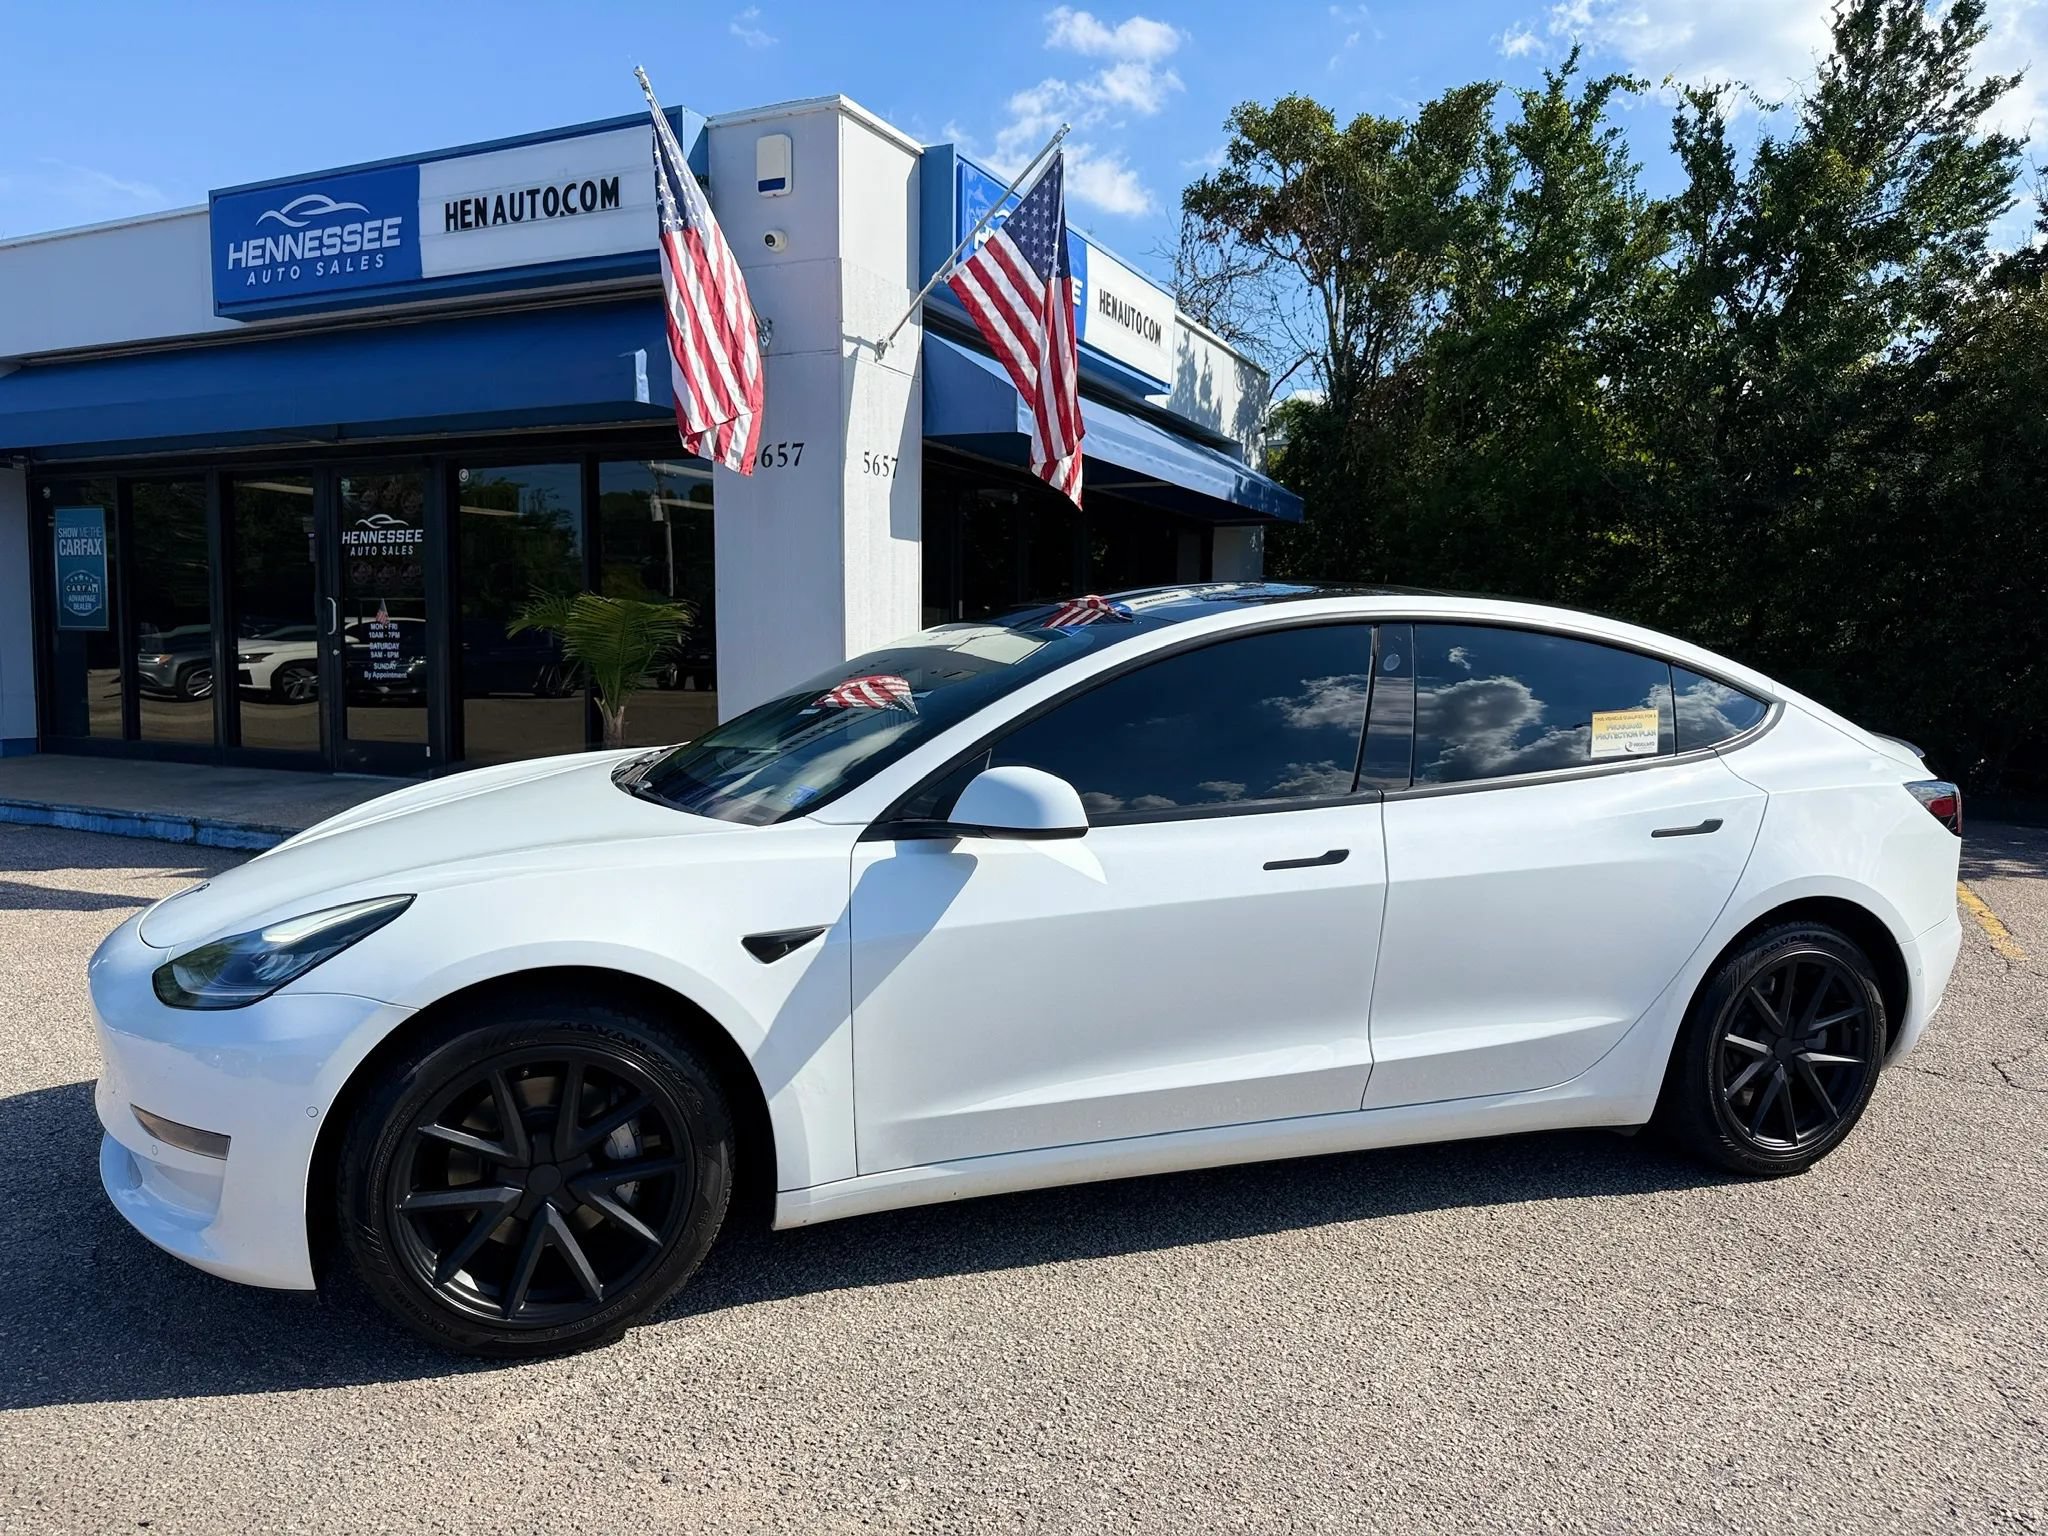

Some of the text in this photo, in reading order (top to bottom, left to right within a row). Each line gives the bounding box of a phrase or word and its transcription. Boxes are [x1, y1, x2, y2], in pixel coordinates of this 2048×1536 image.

[228, 216, 403, 270] HENNESSEE
[247, 253, 384, 286] AUTO SALES
[753, 442, 805, 469] 657
[863, 449, 899, 479] 5657
[58, 527, 78, 538] SHOW
[341, 529, 424, 545] HENNESSEE
[59, 538, 103, 556] CARFAX
[350, 545, 414, 557] AUTO SALES
[68, 594, 97, 603] ADVANTAGE
[73, 602, 92, 610] DEALER
[368, 631, 384, 639] 10AM
[369, 642, 400, 650] SATURDAY
[373, 662, 397, 670] SUNDAY
[372, 671, 407, 680] Appointment
